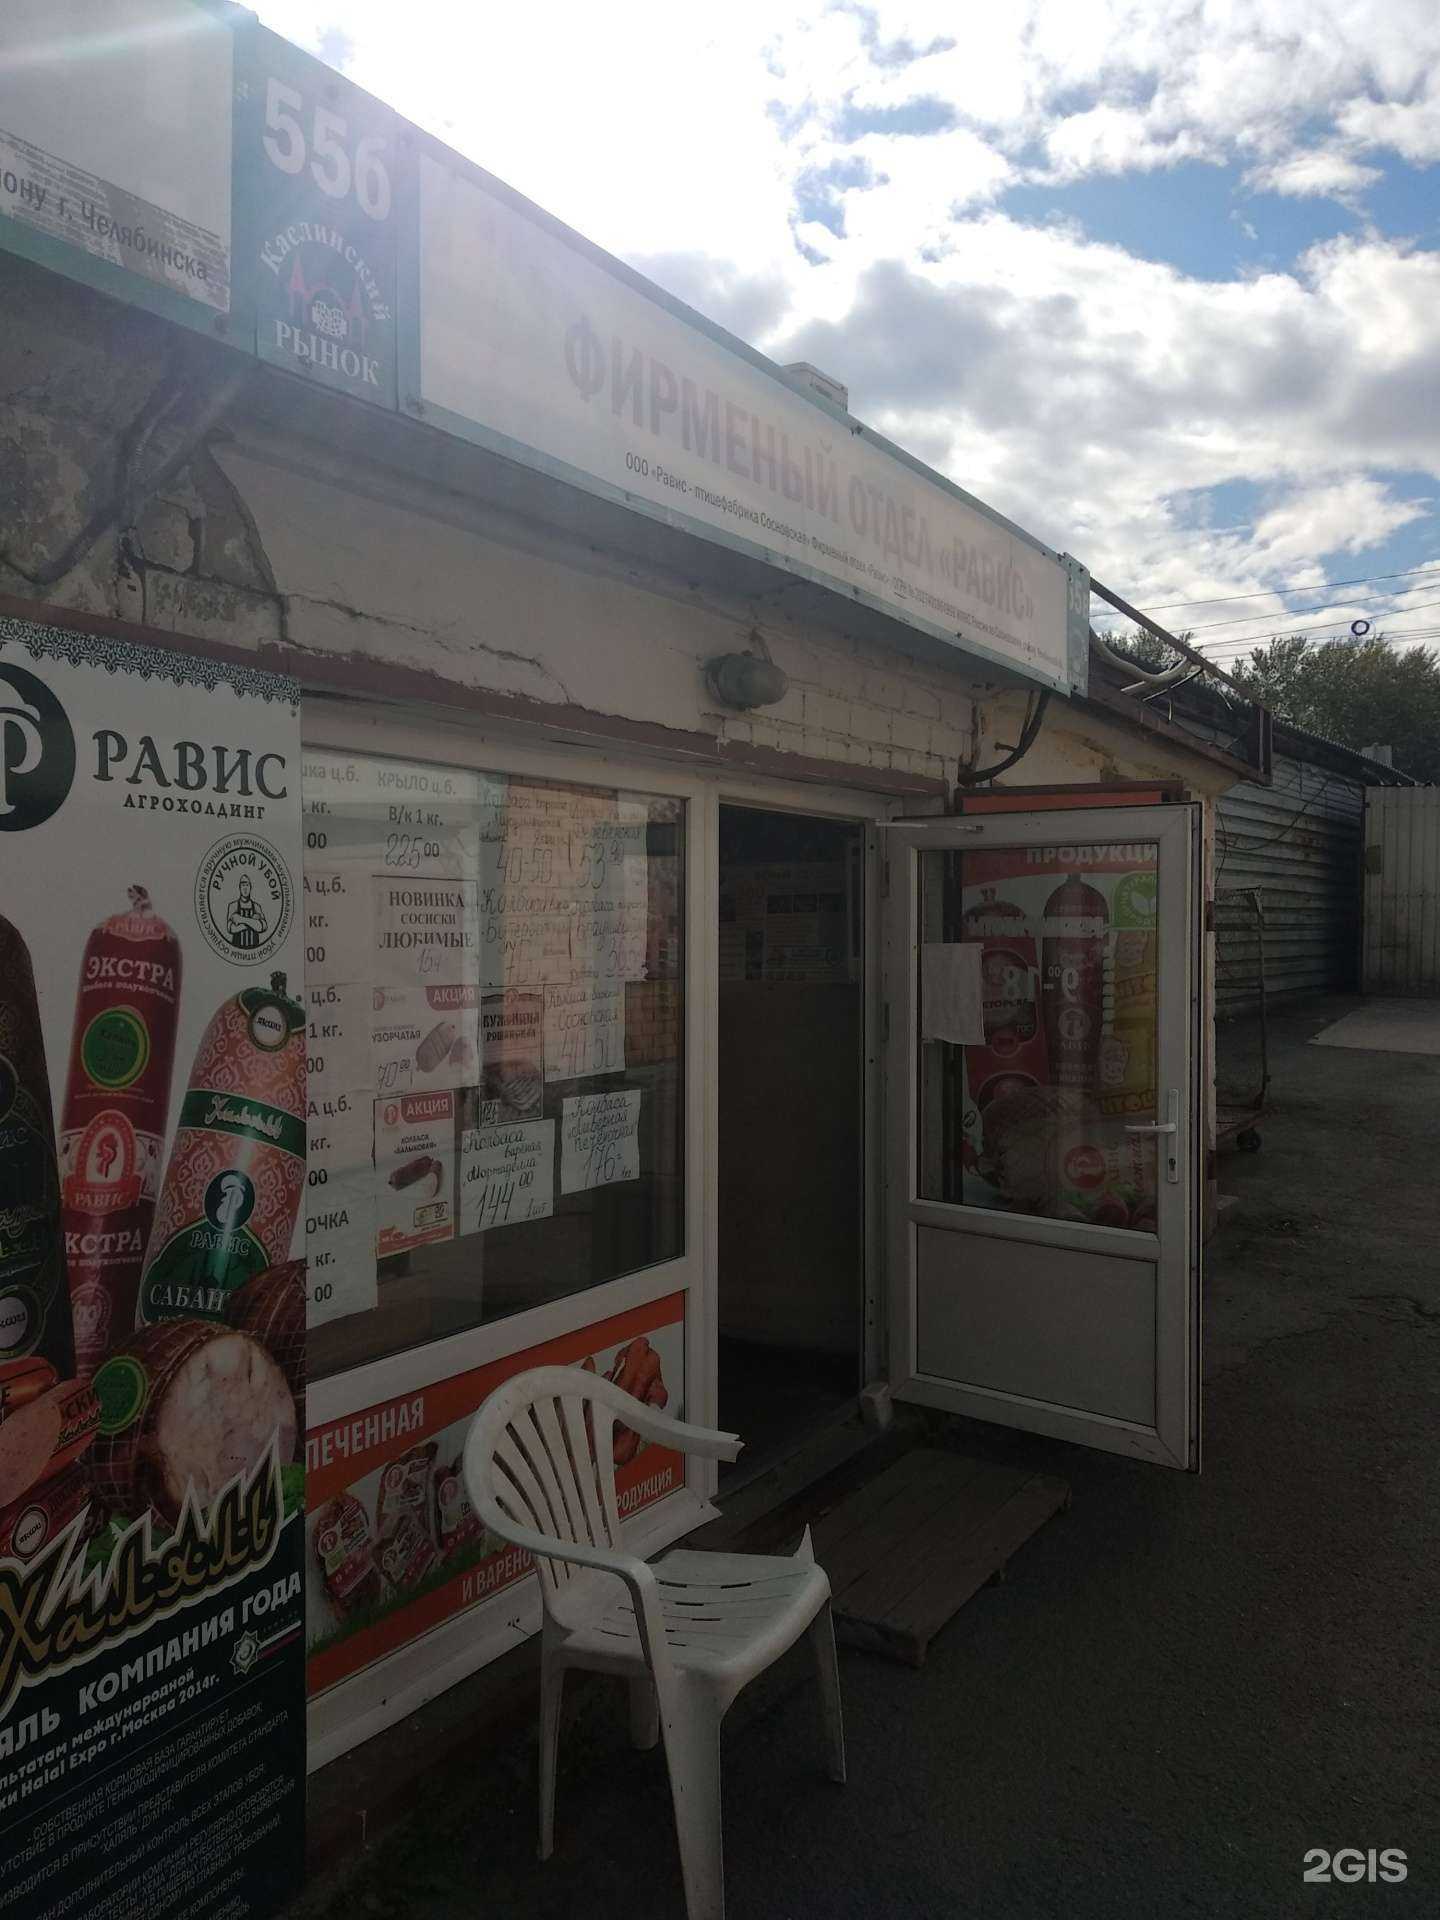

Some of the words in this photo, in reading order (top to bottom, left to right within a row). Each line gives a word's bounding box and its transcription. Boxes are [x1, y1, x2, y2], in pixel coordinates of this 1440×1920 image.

[262, 77, 391, 221] 556
[0, 168, 48, 212] ону
[58, 199, 74, 221] г.
[80, 200, 209, 282] Челябинска
[259, 220, 391, 321] Каслинский
[274, 318, 380, 387] РЫНОК
[563, 314, 841, 525] ФИРМЕНЫЙ
[848, 476, 932, 572] ОТДЕЛ
[625, 451, 649, 477] ООО
[695, 486, 760, 525] птицефабрика
[92, 729, 288, 800] РАВИС
[377, 771, 428, 791] КРЫЛО
[123, 793, 265, 820] АГРОХОЛДИНГ
[311, 800, 332, 815] кг.
[389, 806, 413, 825] В/к
[416, 809, 423, 825] 1
[427, 813, 444, 827] кг.
[307, 832, 327, 849] 00
[213, 853, 257, 890] РУЧНОЙ
[257, 859, 282, 901] УБОЙ
[316, 877, 346, 896] ц.б.
[389, 890, 465, 909] НОВИНКА
[309, 915, 329, 928] кг.
[400, 912, 456, 926] СОСИСКИ
[307, 946, 325, 964] 00
[86, 955, 175, 992] ЭКСТРА
[311, 987, 341, 1006] ц.б.
[433, 988, 475, 1002] АКЦИЯ
[309, 1023, 318, 1039] 1
[322, 1025, 343, 1038] кг.
[371, 1029, 422, 1044] УЗОРЧАТАЯ
[306, 1056, 324, 1074] 00
[323, 1095, 352, 1117] ц.б.
[405, 1098, 450, 1117] АКЦИЯ
[310, 1137, 331, 1152] кг.
[463, 1128, 526, 1154] Колбаса
[308, 1168, 328, 1187] 00
[477, 1180, 516, 1229] 144
[305, 1210, 350, 1234] ОЧКА
[315, 1251, 336, 1267] кг.
[149, 1283, 232, 1313] САБАН
[314, 1283, 333, 1303] 00
[305, 1396, 425, 1472] ПЕЧЕННАЯ
[461, 1577, 477, 1602] И
[78, 1606, 235, 1716] КОМПАНИЯ
[241, 1571, 302, 1625] ГОДА
[71, 1668, 195, 1749] международной
[21, 1761, 65, 1799] Halal
[68, 1741, 108, 1776] Expo
[110, 1698, 177, 1747] г.Москва
[178, 1675, 221, 1711] 2014г.
[32, 1784, 103, 1844] СОБСТВЕННАЯ
[105, 1753, 152, 1798] КОРМОВАЯ
[57, 1798, 104, 1842] ПРОДУКТЕ
